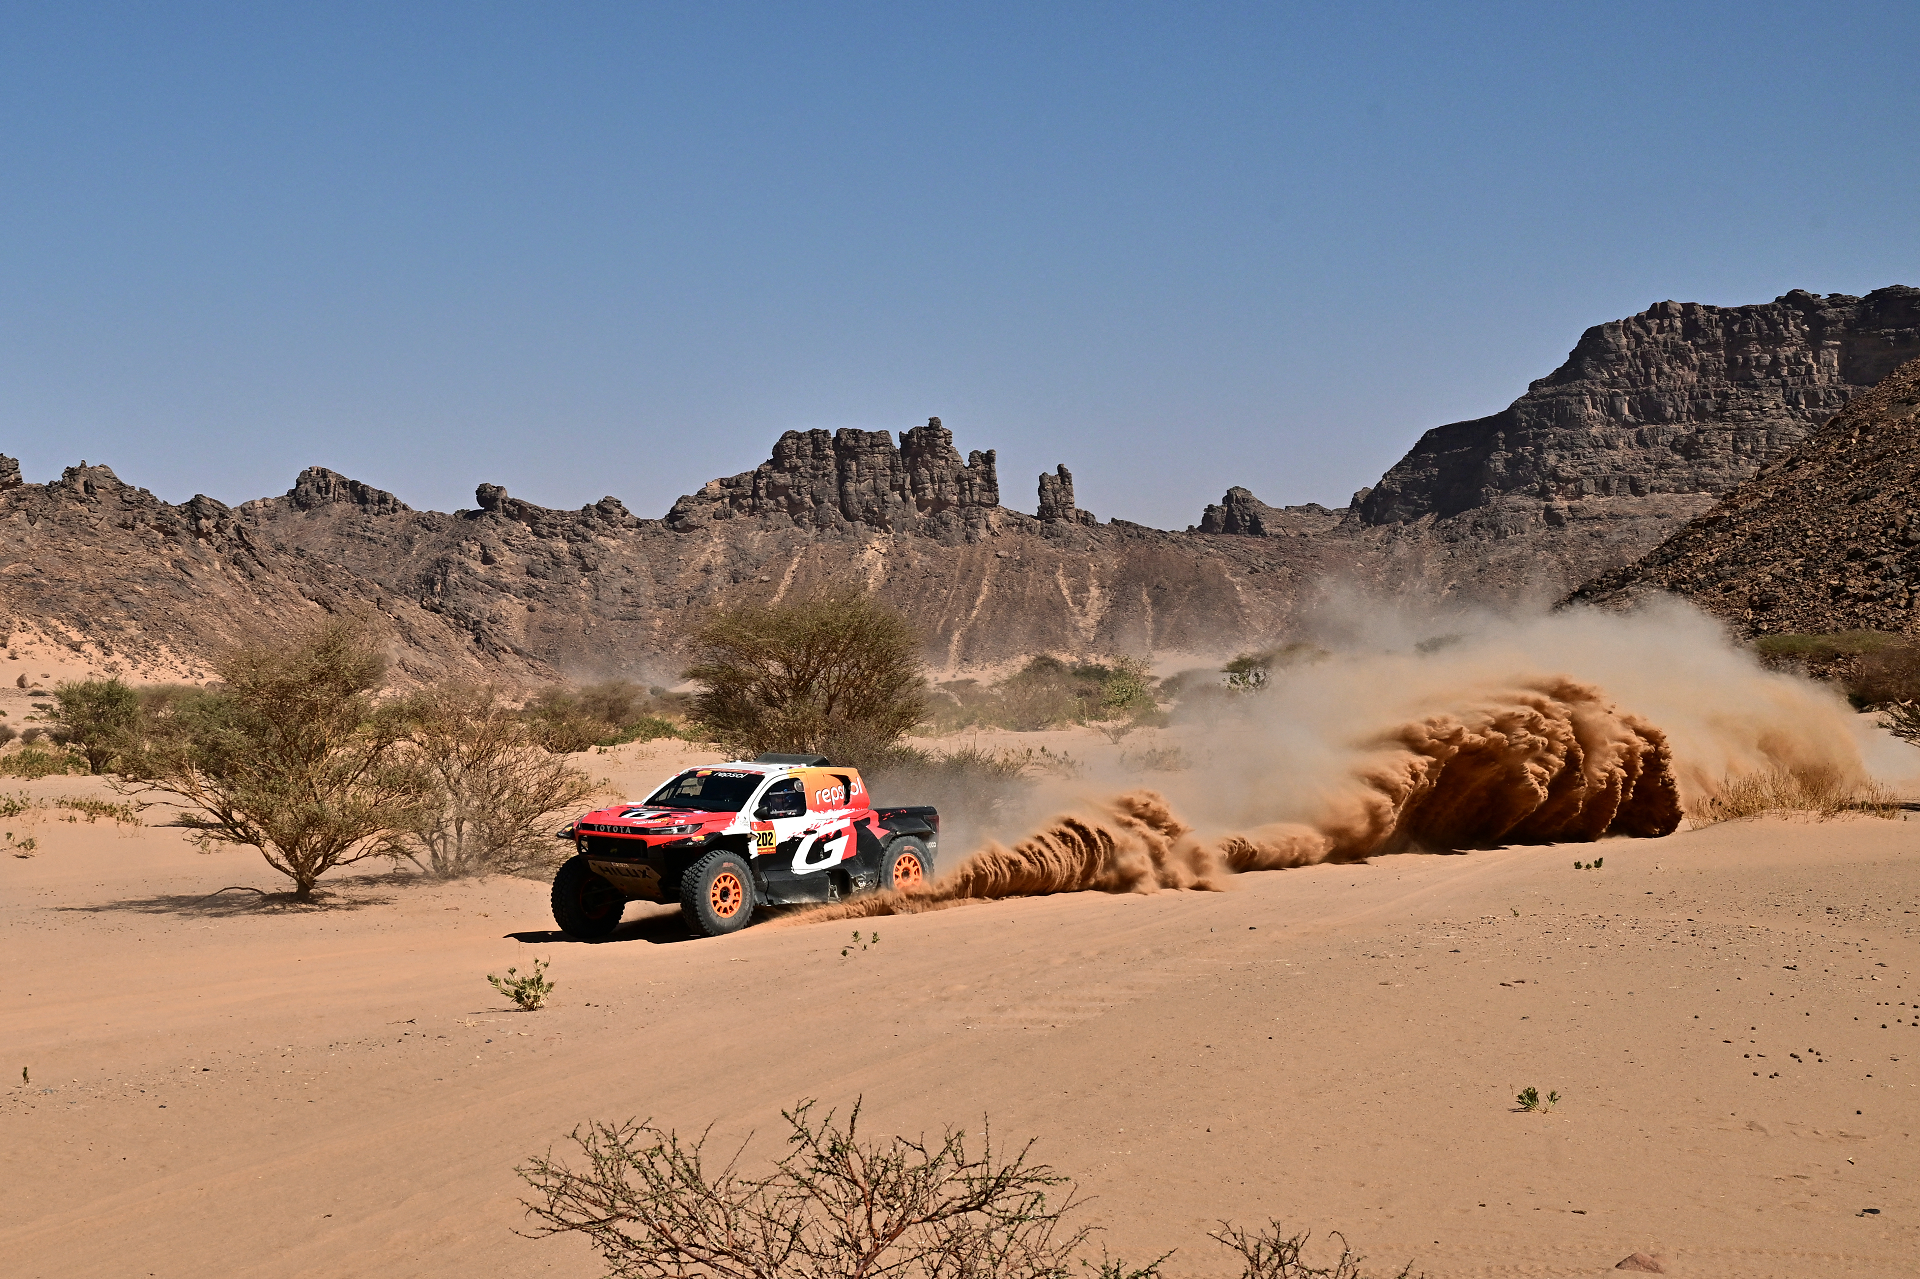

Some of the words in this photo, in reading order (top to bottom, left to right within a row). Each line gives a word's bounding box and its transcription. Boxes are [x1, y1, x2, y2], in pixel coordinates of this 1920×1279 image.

[713, 771, 749, 779] repsol
[815, 776, 863, 805] repsol
[593, 823, 632, 834] TOYOTA
[756, 831, 774, 847] 202
[598, 865, 653, 879] HILUX
